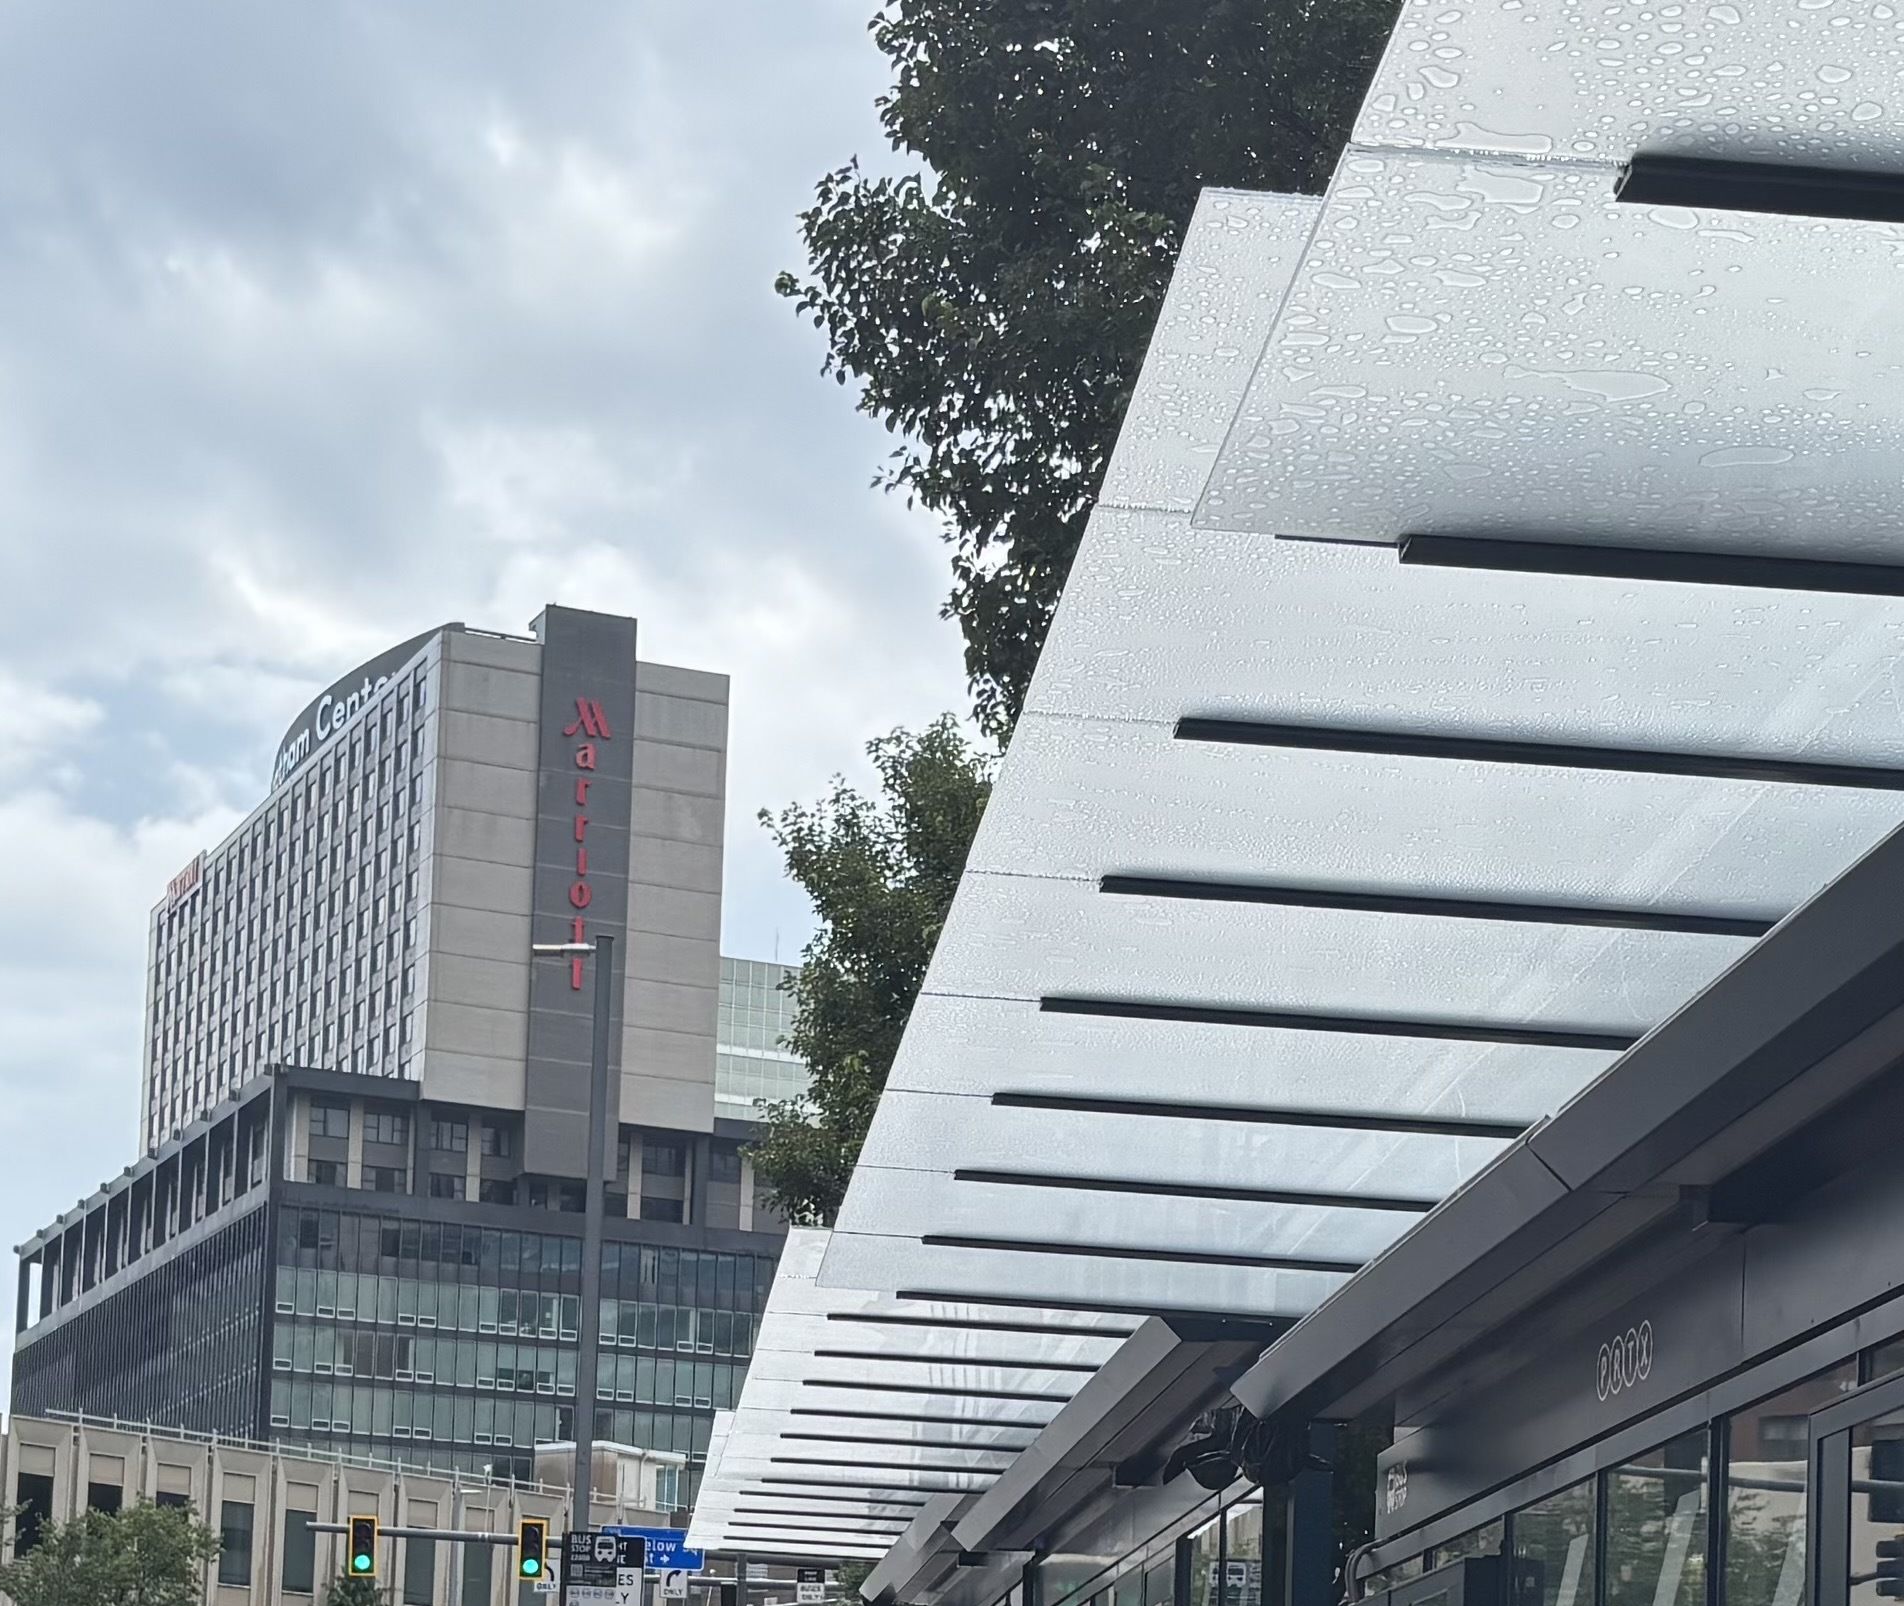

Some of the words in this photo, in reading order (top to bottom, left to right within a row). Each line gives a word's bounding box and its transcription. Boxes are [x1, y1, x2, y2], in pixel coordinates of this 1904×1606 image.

[562, 696, 612, 991] Marriott
[571, 1534, 592, 1545] BUS
[646, 1539, 677, 1552] elow
[571, 1544, 592, 1553] STOP
